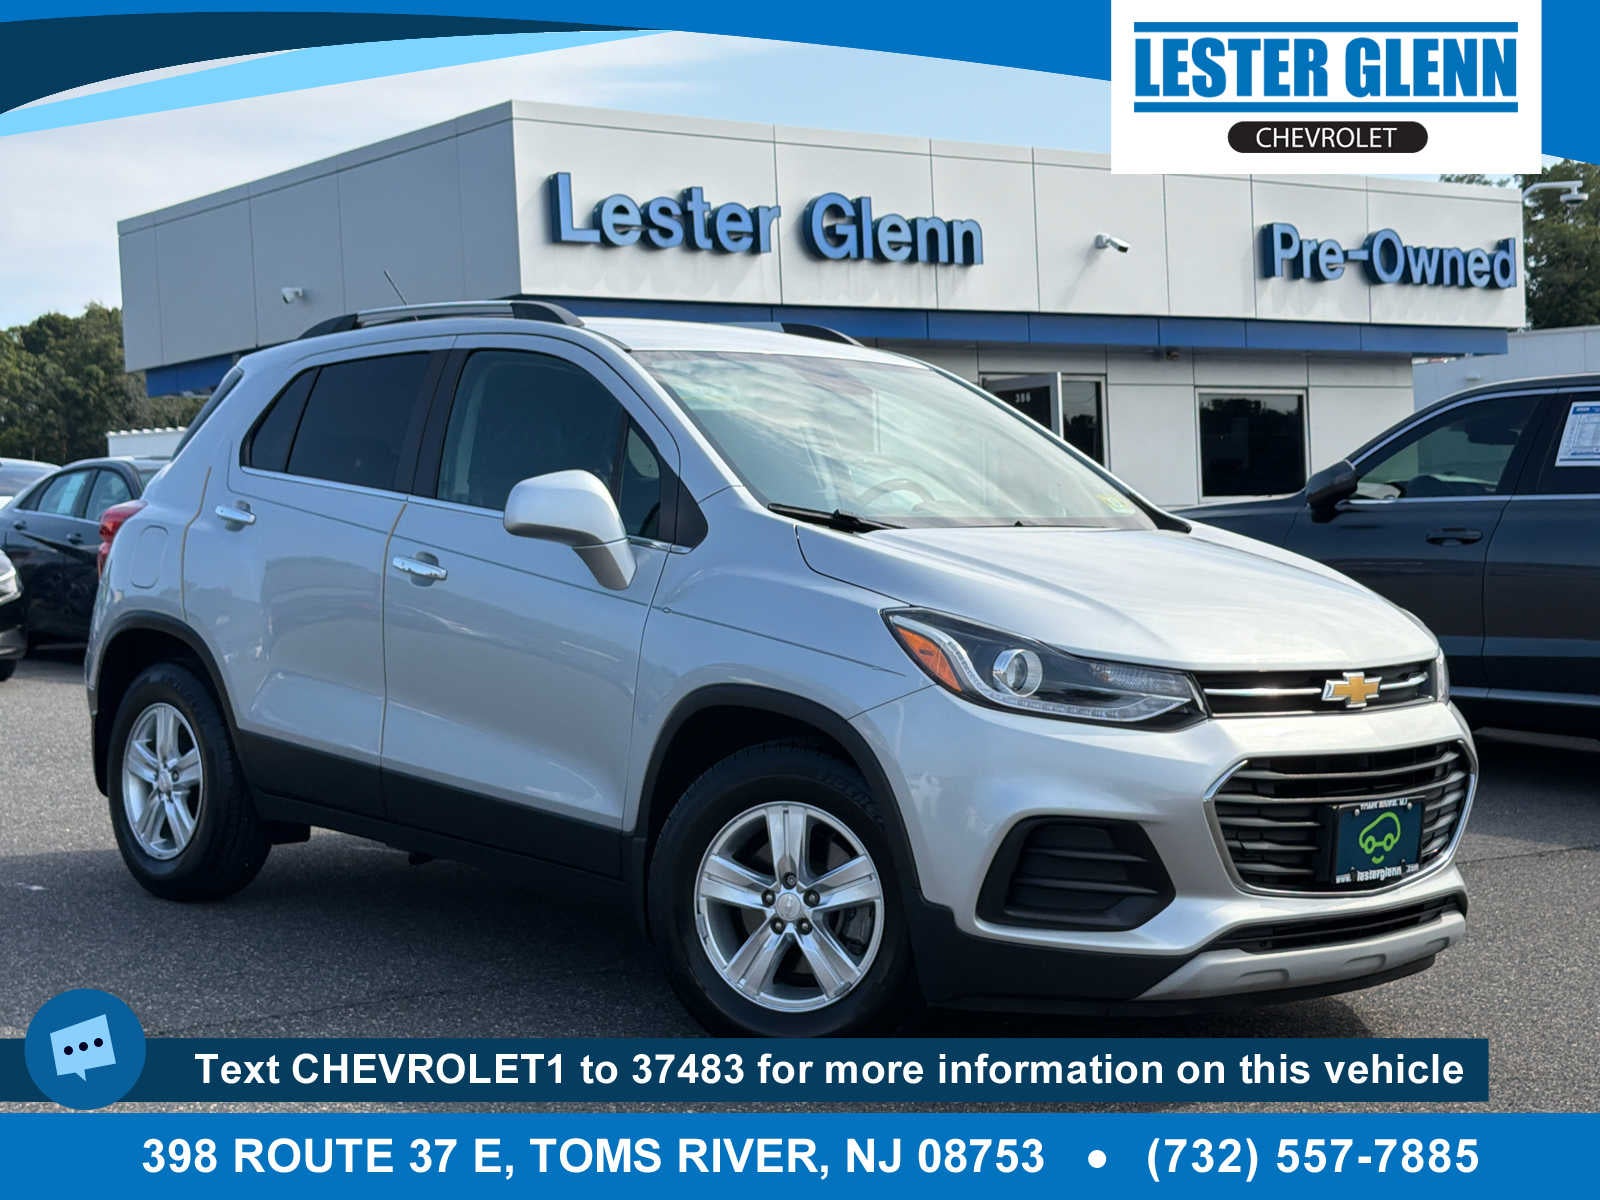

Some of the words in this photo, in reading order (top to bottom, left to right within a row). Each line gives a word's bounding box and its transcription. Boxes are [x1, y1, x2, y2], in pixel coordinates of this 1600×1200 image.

[547, 172, 781, 253] Lester
[803, 192, 984, 265] Glenn
[1260, 222, 1517, 289] Pre-Owned
